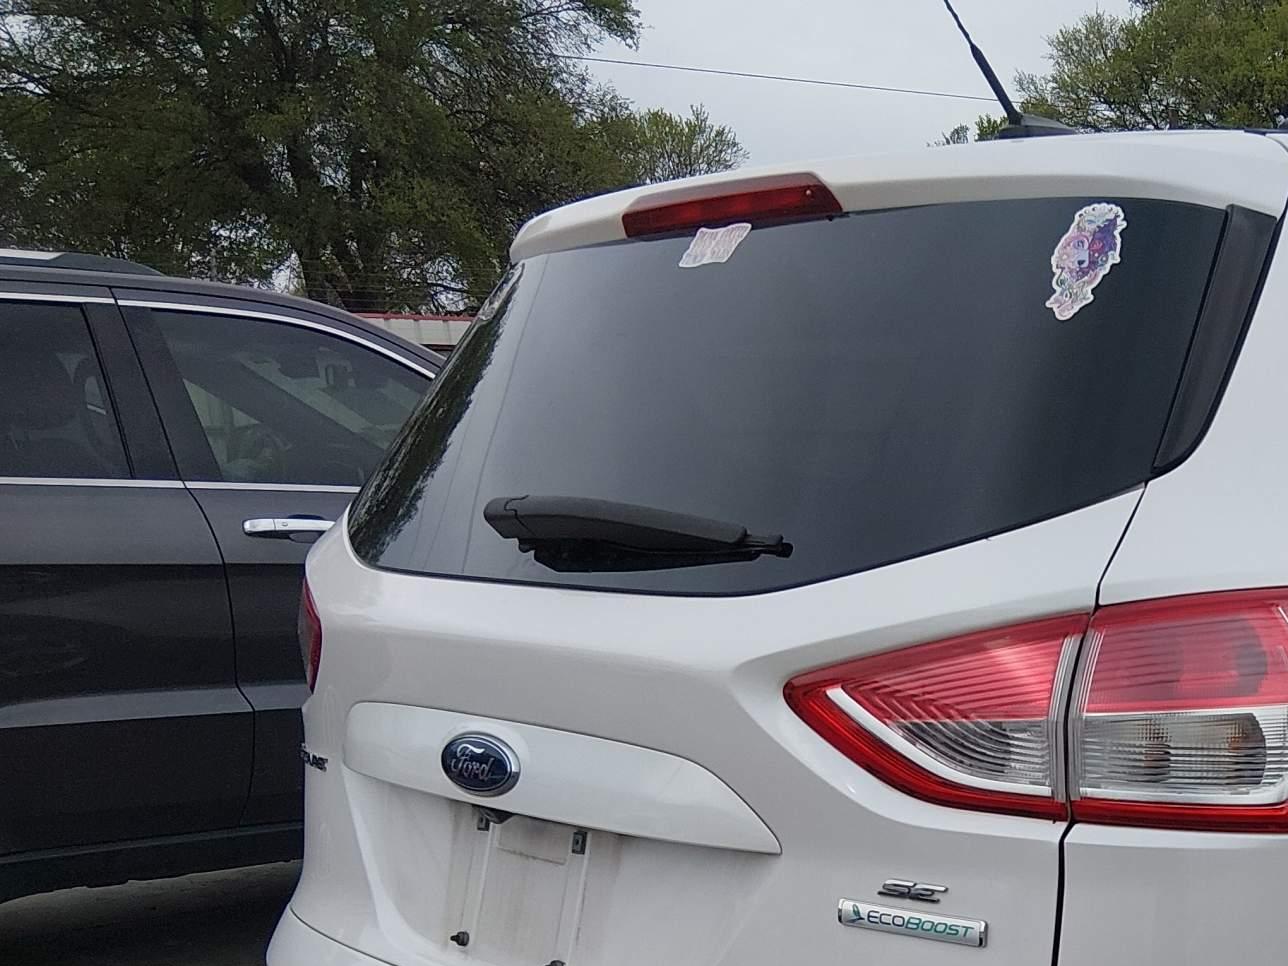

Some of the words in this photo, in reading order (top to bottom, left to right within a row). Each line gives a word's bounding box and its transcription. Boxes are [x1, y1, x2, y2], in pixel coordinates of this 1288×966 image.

[450, 743, 505, 781] Ford
[877, 878, 949, 904] SE
[866, 909, 975, 938] ECOBOOST
